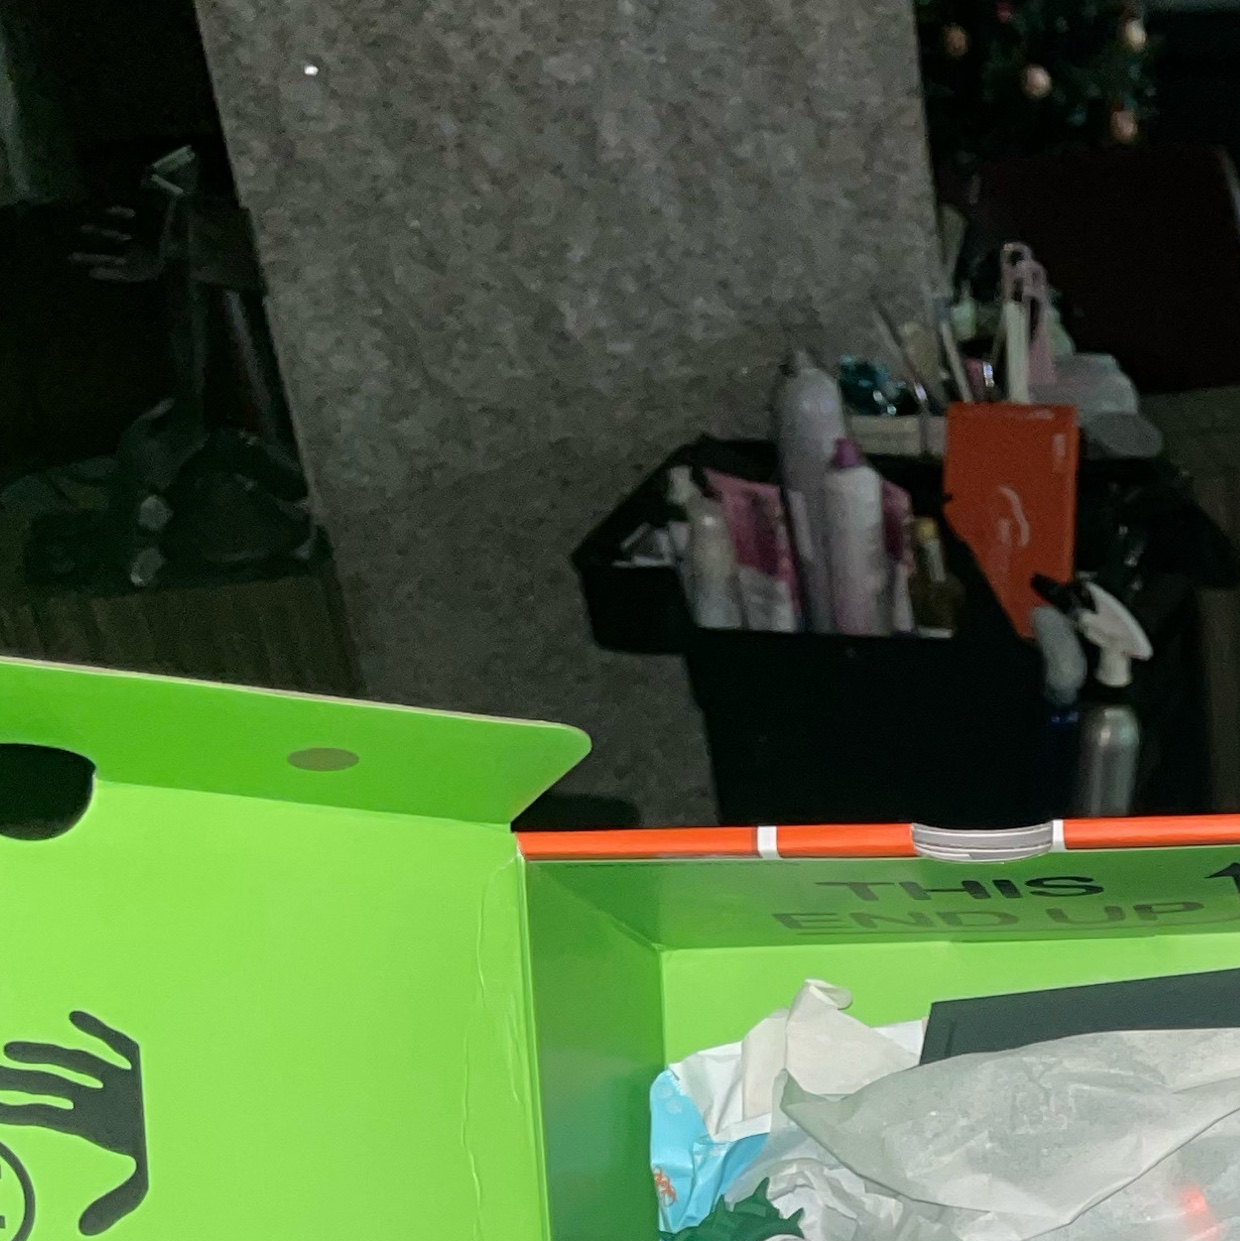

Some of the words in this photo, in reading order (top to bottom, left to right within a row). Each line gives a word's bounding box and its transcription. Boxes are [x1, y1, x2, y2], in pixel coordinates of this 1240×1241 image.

[814, 875, 1105, 901] THIS
[771, 909, 1020, 930] END
[1046, 901, 1205, 925] UP
